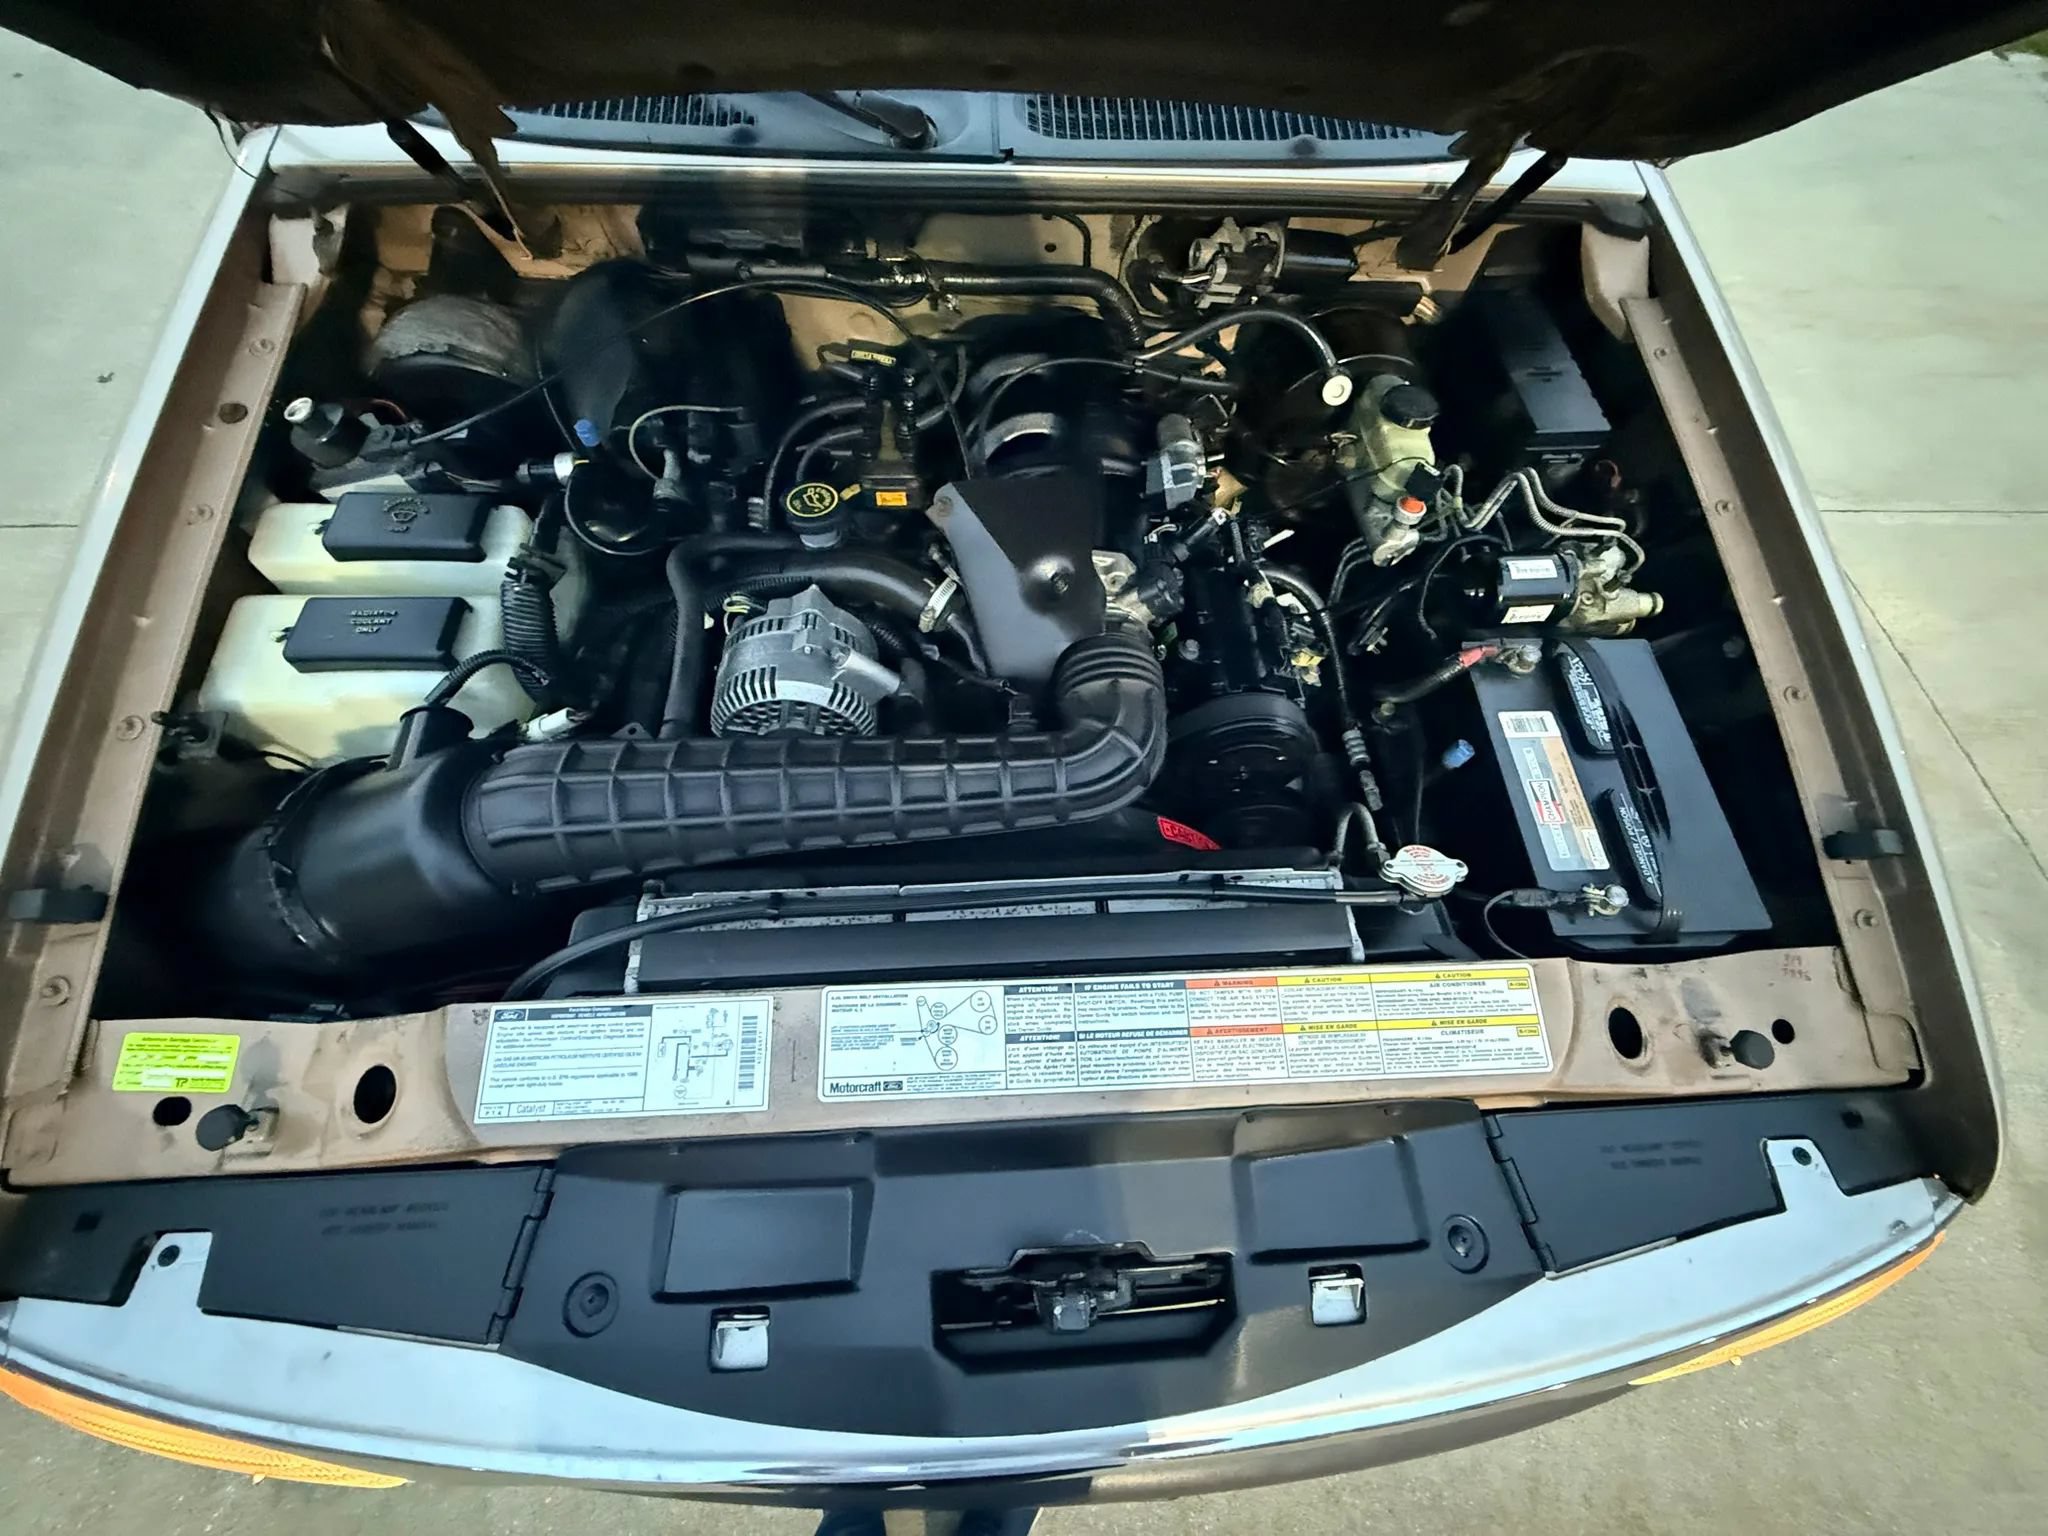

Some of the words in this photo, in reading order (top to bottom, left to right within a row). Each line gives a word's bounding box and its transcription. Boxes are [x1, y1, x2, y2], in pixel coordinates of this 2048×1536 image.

[350, 618, 393, 626] COOLANT
[500, 1011, 519, 1020] Ford
[1095, 1031, 1121, 1039] MOTEUR
[830, 1081, 882, 1094] Motorcraft
[516, 1104, 547, 1114] Catalyst
